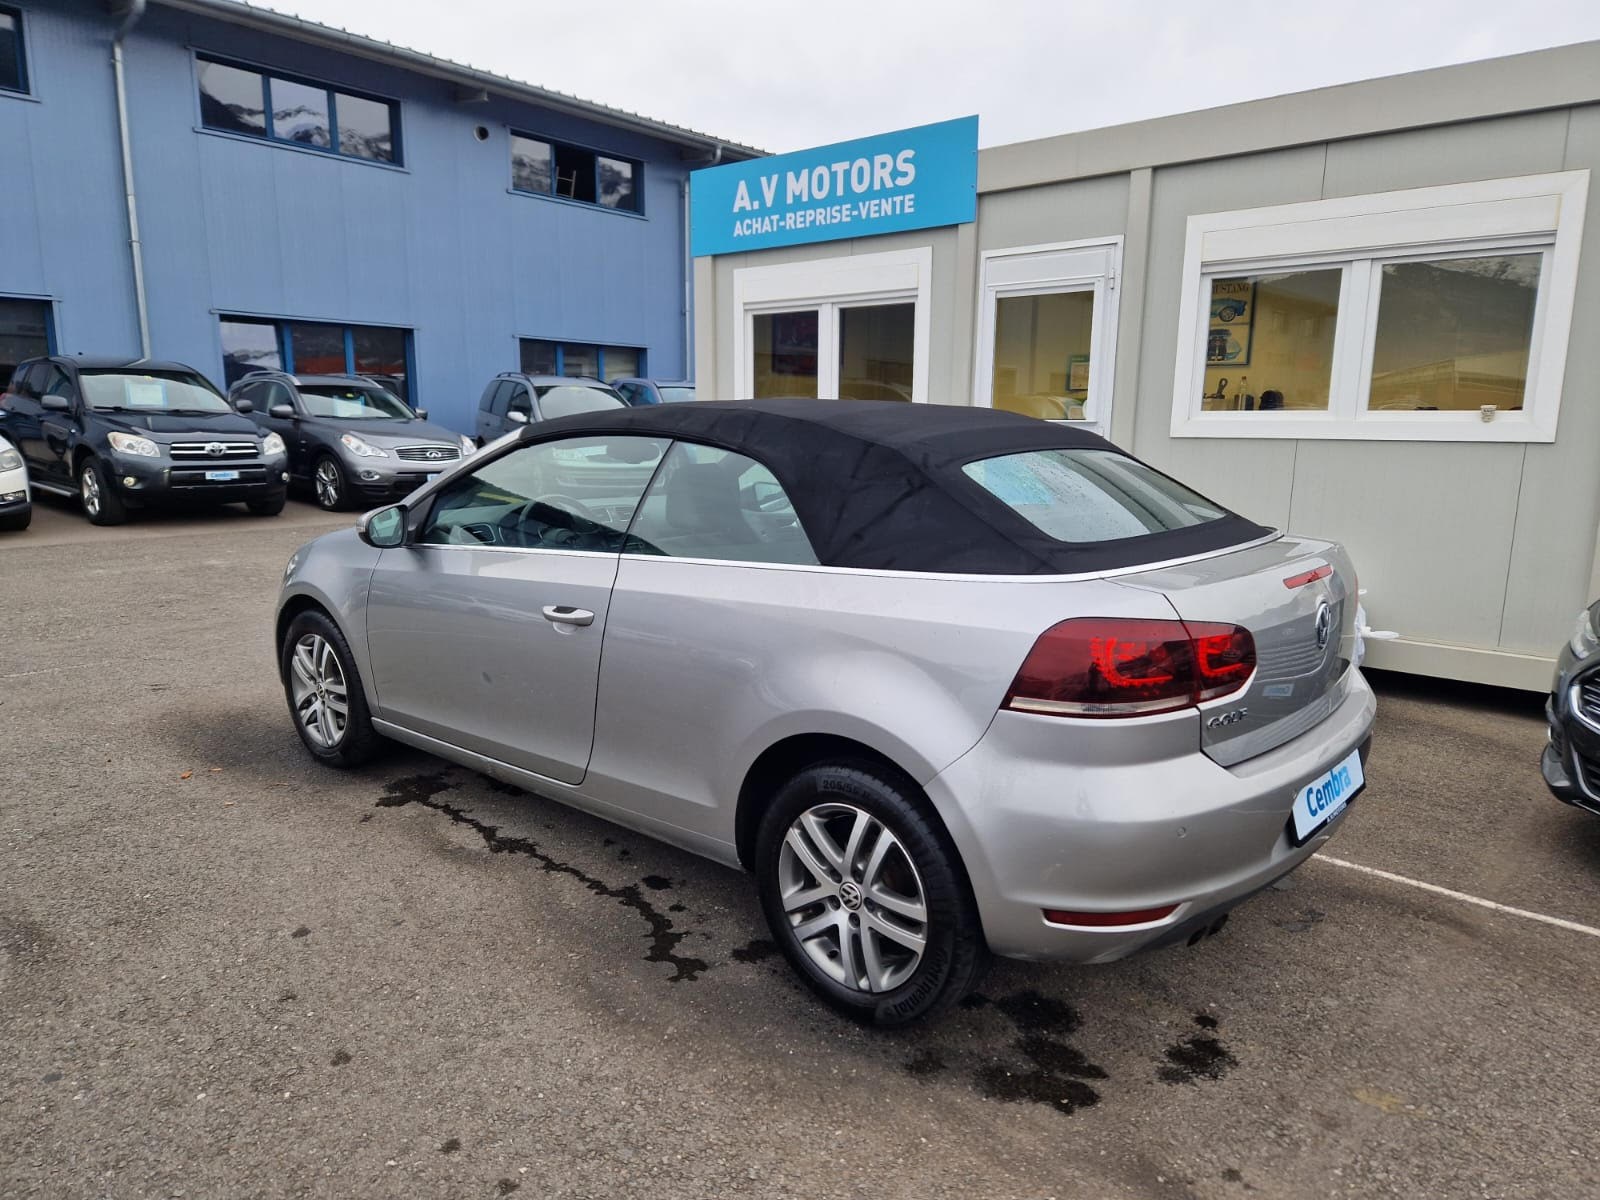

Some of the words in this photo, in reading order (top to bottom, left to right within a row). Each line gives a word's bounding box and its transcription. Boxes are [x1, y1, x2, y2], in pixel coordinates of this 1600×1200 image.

[733, 174, 778, 213] A.V
[786, 149, 916, 204] MOTORS
[733, 194, 915, 237] ACHAT-REPRISE-VENTE
[1212, 282, 1250, 294] USTANG
[1207, 707, 1247, 728] GOLF
[1306, 766, 1351, 817] Cembra
